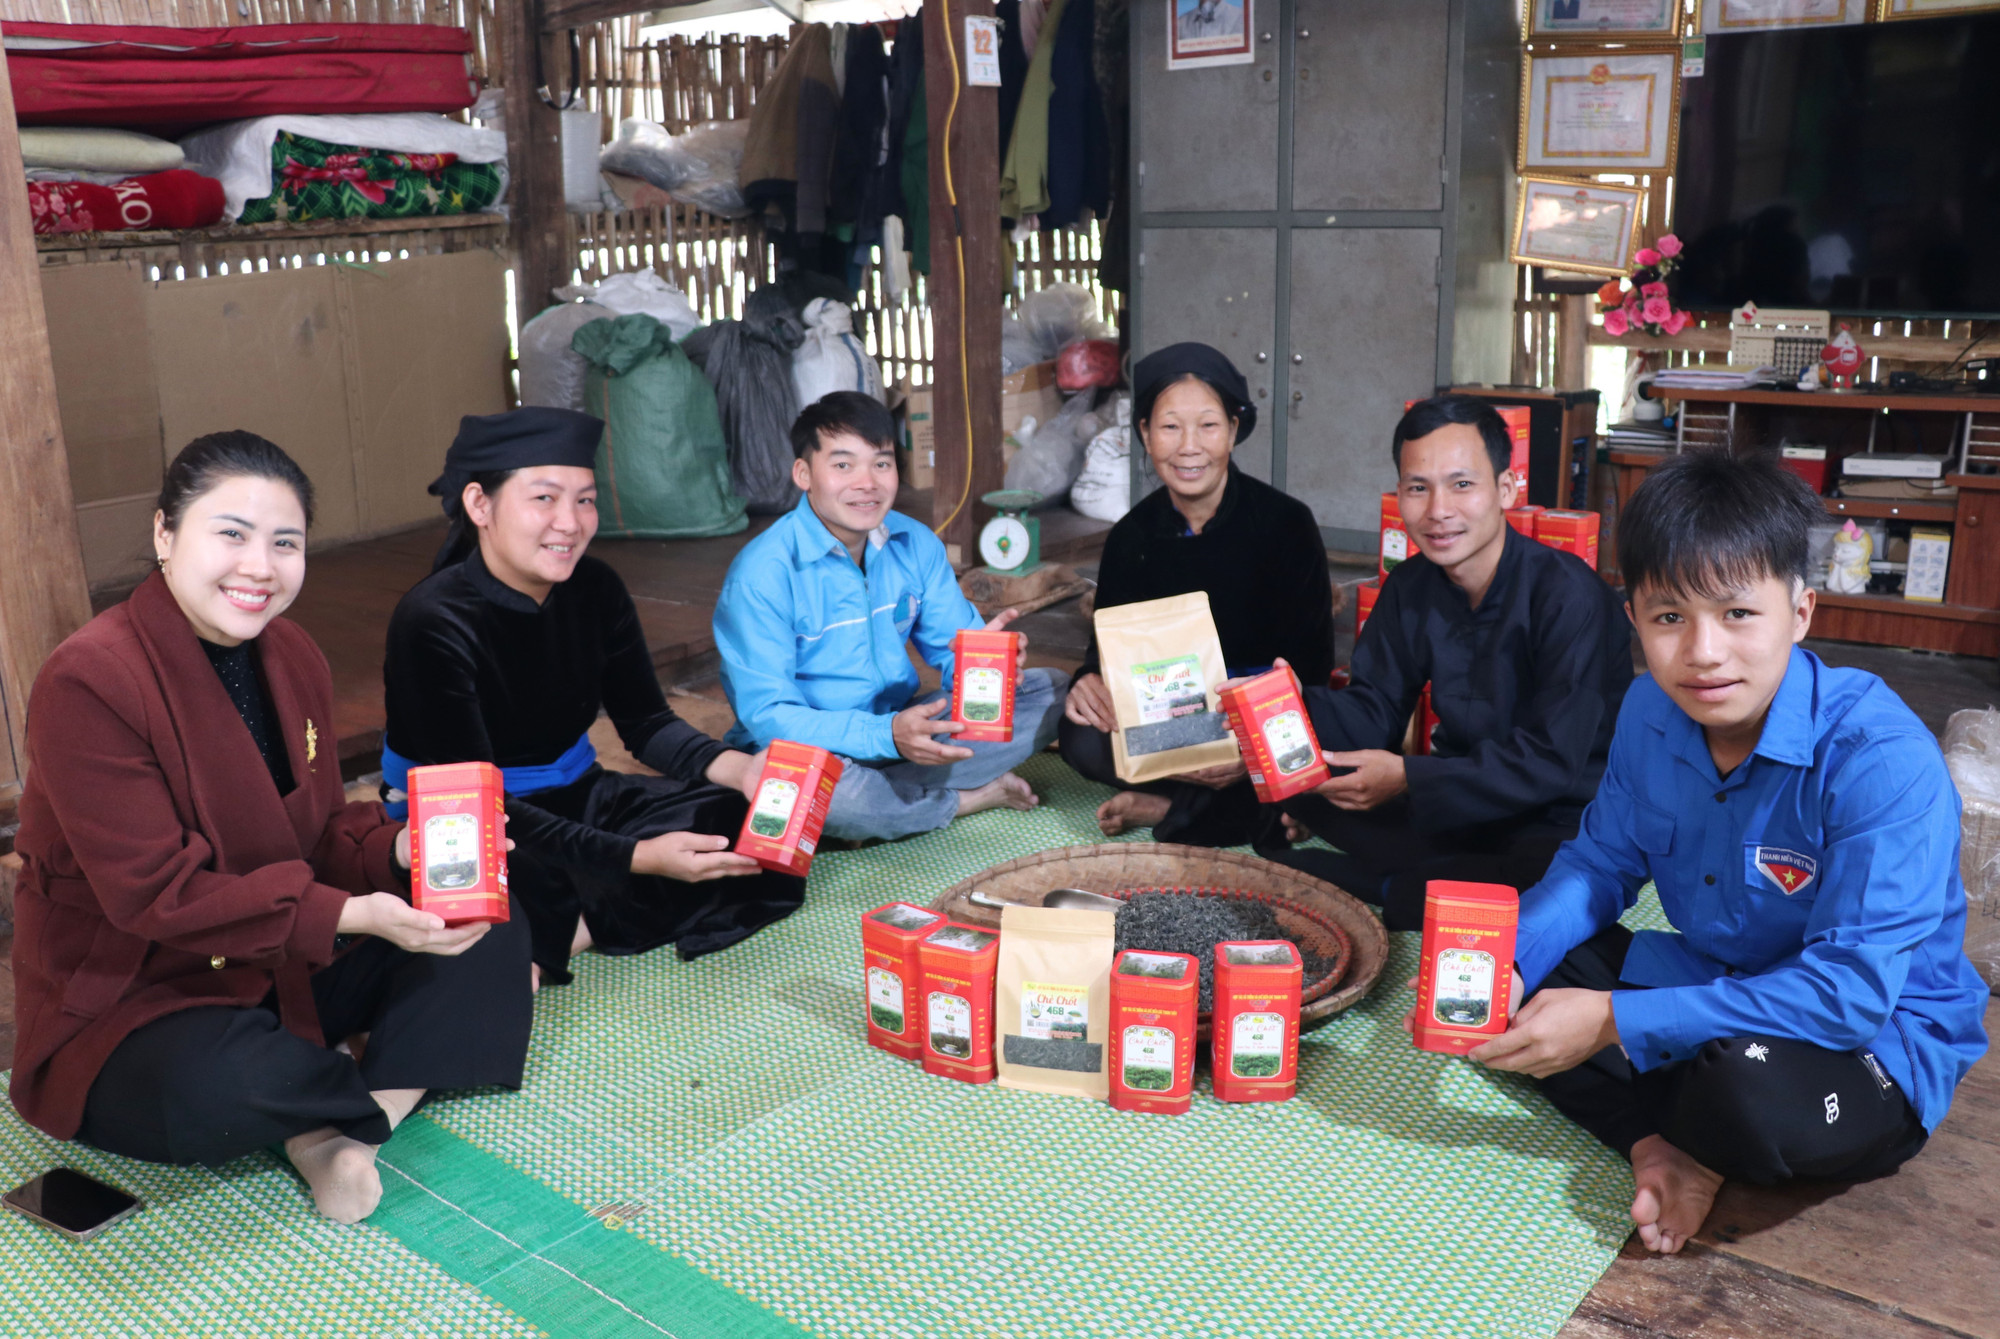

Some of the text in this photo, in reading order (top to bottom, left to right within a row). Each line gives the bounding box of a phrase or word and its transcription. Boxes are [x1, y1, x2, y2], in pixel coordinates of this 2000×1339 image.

[973, 29, 992, 55] 22
[1781, 854, 1793, 863] NIÊN
[1793, 857, 1804, 868] VIỆT
[1458, 974, 1471, 982] 468
[1047, 1006, 1064, 1015] 468
